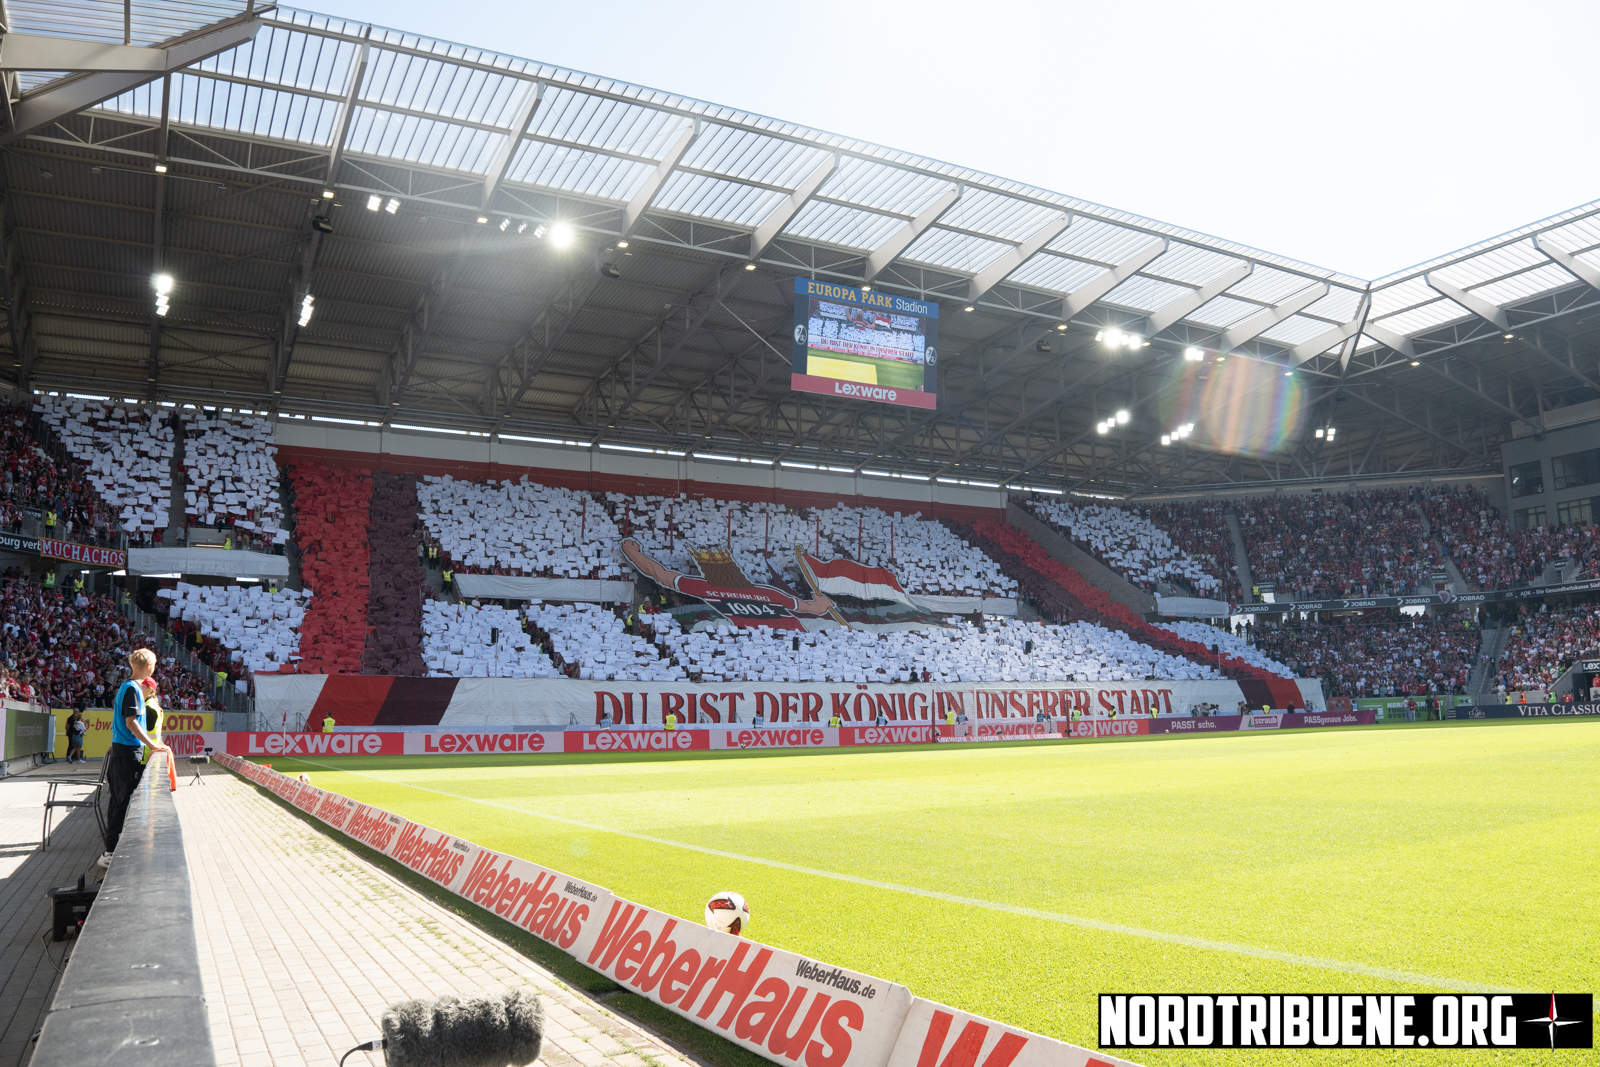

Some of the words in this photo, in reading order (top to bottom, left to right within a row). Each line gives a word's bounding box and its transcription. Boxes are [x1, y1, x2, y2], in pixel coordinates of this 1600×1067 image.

[808, 282, 857, 302] EUROPA
[861, 292, 893, 308] PARK
[896, 299, 928, 315] Stadion
[834, 382, 898, 401] Lexware
[41, 539, 125, 565] MUCHACHOS
[719, 592, 771, 602] FREIBURG
[726, 602, 776, 616] 1904
[1583, 662, 1600, 670] Lex
[593, 691, 649, 725] DU
[659, 692, 745, 724] BIST
[753, 691, 823, 722] DER
[830, 684, 929, 722] KÖNIG
[935, 691, 965, 720] IN
[968, 689, 1091, 719] UNSERER
[1097, 689, 1173, 715] STADT
[1517, 705, 1549, 717] VITA
[1072, 719, 1139, 737] Lexware
[1171, 720, 1195, 730] PASST
[1198, 720, 1217, 729] scho.
[1254, 716, 1278, 725] straub
[1304, 715, 1341, 725] PASSgenaue
[1342, 714, 1358, 723] Jobs.
[726, 728, 824, 748] Lexware
[854, 726, 941, 744] Lexware
[968, 723, 1045, 737] Lexware
[164, 733, 205, 756] exware
[249, 733, 382, 754] Lexware
[425, 733, 545, 752] Lexware
[582, 731, 692, 750] Lexware
[345, 804, 397, 851] WeberHaus
[391, 822, 465, 886] WeberHaus
[459, 850, 590, 949] WeberHaus
[564, 880, 598, 903] WeberHaus.de
[587, 899, 865, 1067] WeberHaus
[796, 959, 877, 1000] WeberHaus.de
